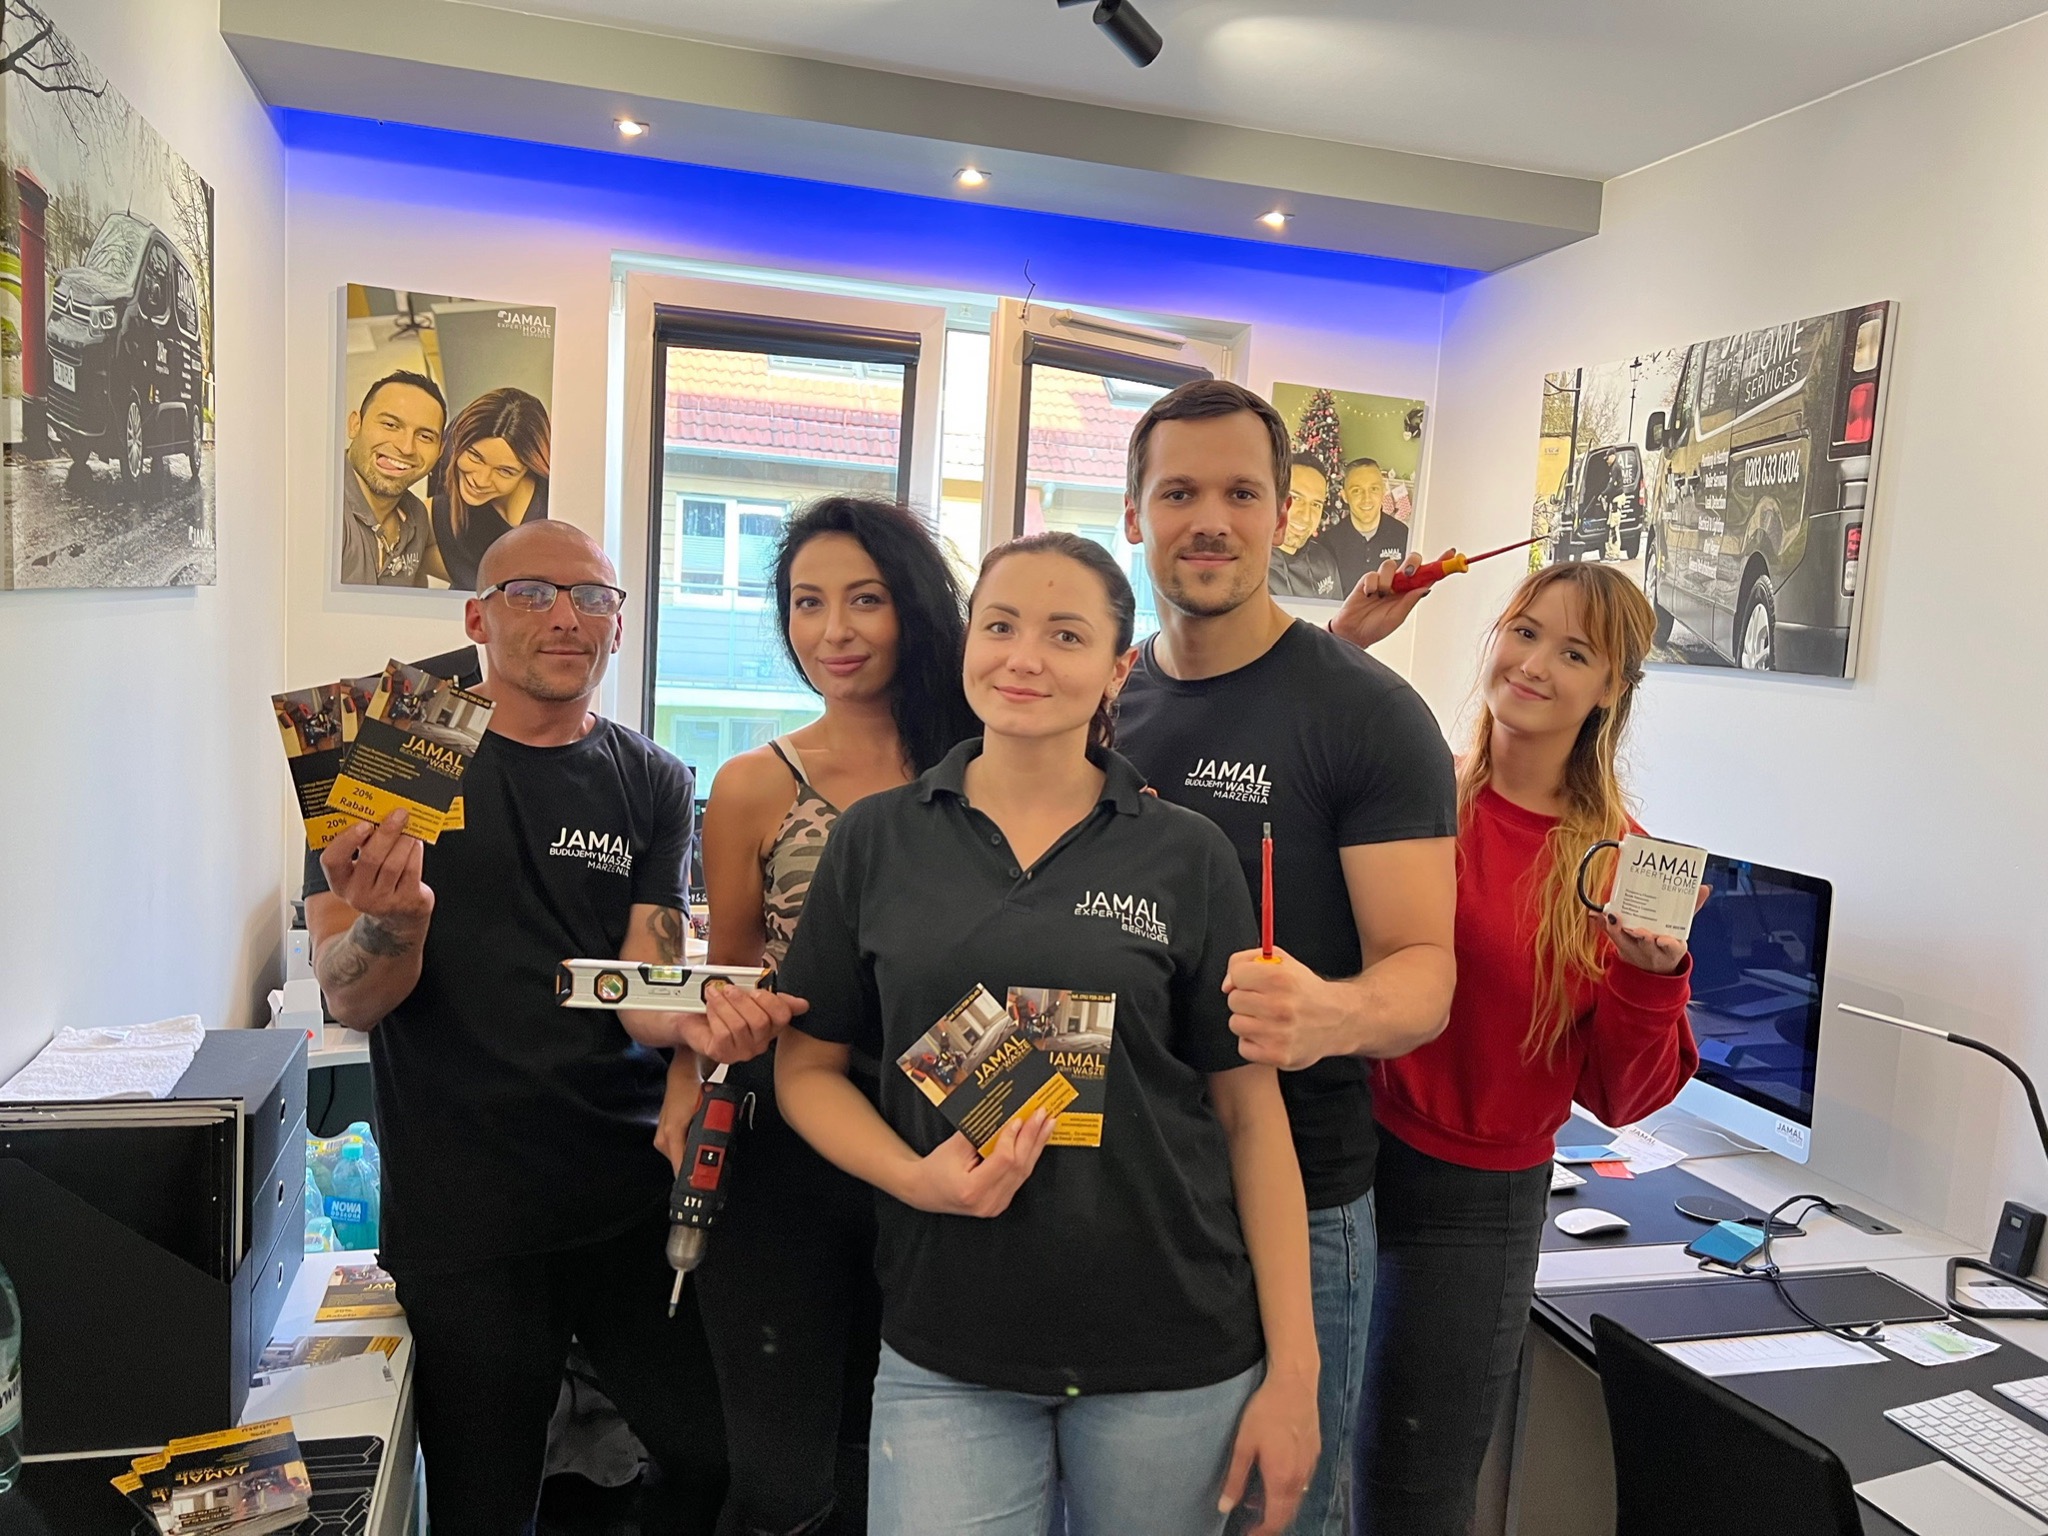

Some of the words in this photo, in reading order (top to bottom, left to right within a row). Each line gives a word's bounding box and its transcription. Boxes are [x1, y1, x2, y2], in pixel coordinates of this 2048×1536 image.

[504, 312, 551, 328] JAMAL
[522, 325, 551, 335] HOME
[1748, 320, 1803, 378] HOME
[1744, 358, 1799, 403] SERVICES
[1744, 457, 1761, 487] 0203
[1762, 453, 1777, 485] 633
[1778, 449, 1801, 483] 0304
[402, 735, 464, 770] JAMAL
[430, 759, 463, 777] WASZE
[1187, 758, 1272, 786] JAMAL
[352, 787, 374, 801] 20%
[1184, 778, 1225, 789] BUDUJEMY
[1225, 781, 1271, 797] WASZE
[1213, 790, 1268, 805] MARZENIA
[340, 797, 376, 817] Rabatu
[326, 818, 348, 830] 20%
[551, 827, 633, 860] JAMAL
[549, 847, 598, 860] BUDUJEMY
[598, 852, 632, 870] WASZE
[1632, 849, 1698, 879] JAMAL
[587, 860, 629, 878] MARZENIA
[1629, 866, 1664, 879] EXPERT
[1663, 873, 1698, 889] HOME
[1661, 884, 1696, 896] SERVICES
[1076, 890, 1166, 927] JAMAL
[1074, 907, 1121, 920] EXPERT
[1121, 912, 1168, 938] HOME
[1121, 923, 1169, 945] SERVICES
[977, 1035, 1026, 1086] JAMAL
[1072, 1066, 1104, 1077] WASZE
[1777, 1123, 1803, 1141] JAMAL
[331, 1200, 362, 1214] NOWA
[363, 1282, 396, 1291] JAM
[176, 1465, 249, 1486] JAMAL
